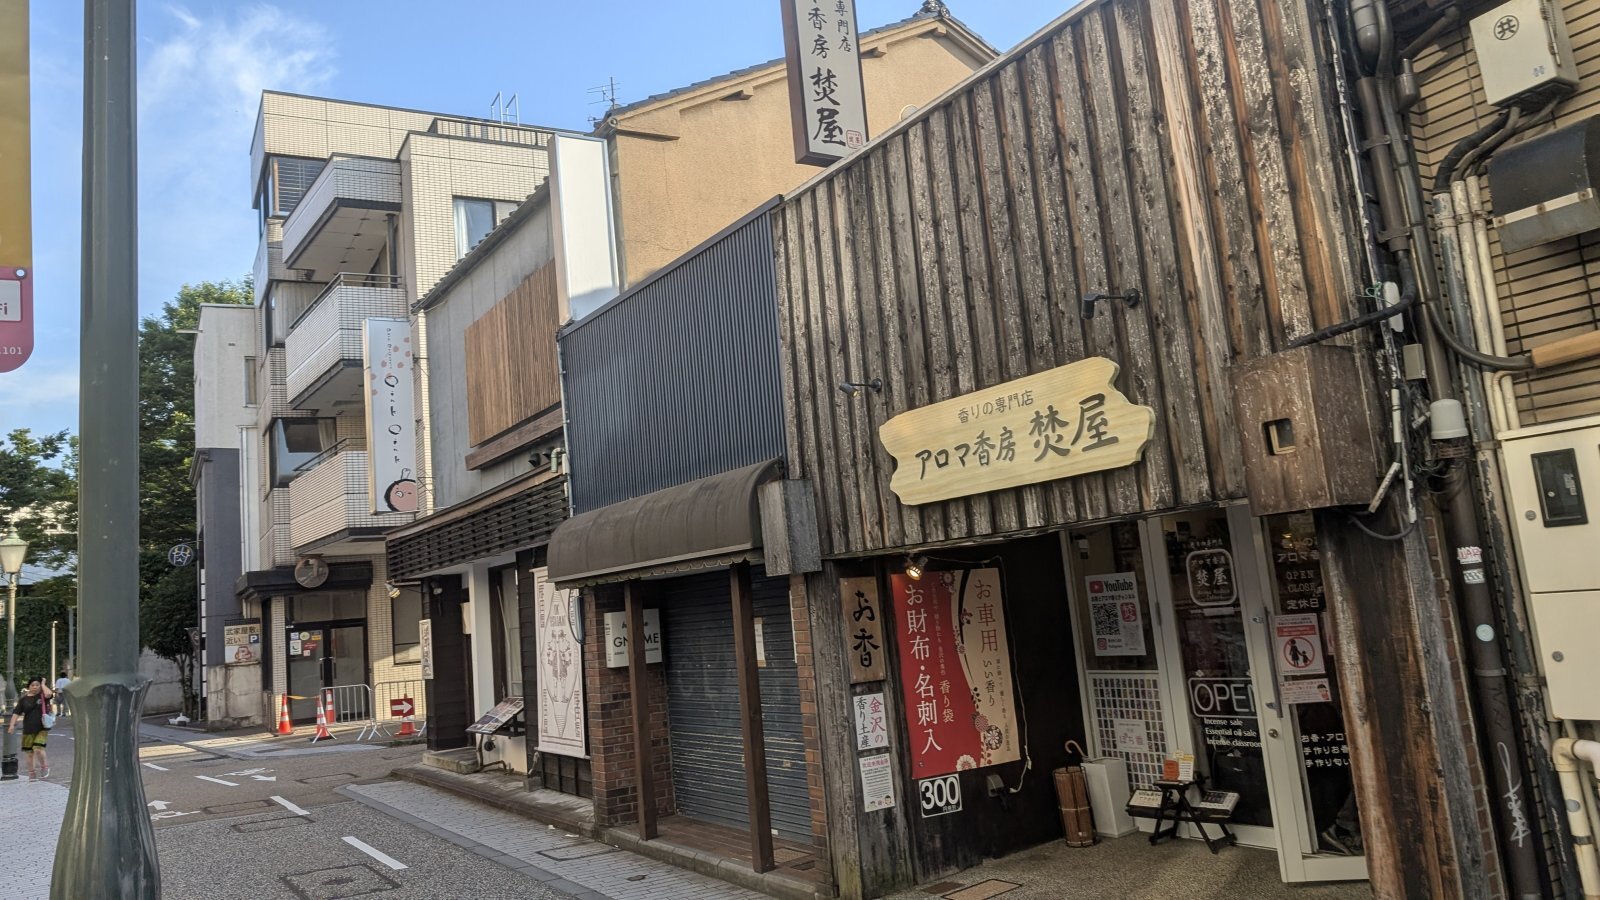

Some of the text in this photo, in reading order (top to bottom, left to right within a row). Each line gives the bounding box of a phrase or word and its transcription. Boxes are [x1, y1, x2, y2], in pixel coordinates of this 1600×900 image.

[1497, 18, 1516, 39] 共
[810, 67, 846, 146] 焚屋
[957, 389, 1034, 424] 香りの専門店
[915, 392, 1119, 480] アロマ香房 焚屋
[1104, 579, 1134, 592] YouTube
[1196, 567, 1228, 586] 焚屋
[1286, 570, 1315, 580] OPEN
[1288, 582, 1316, 593] CLOSE
[1286, 598, 1319, 610] 定休日
[250, 635, 258, 643] P
[853, 589, 880, 668] お香
[226, 637, 241, 645] 近い
[613, 632, 660, 648] GNME
[974, 579, 998, 708] お車用 いい香り
[904, 584, 943, 755] お財布・名刺入
[939, 680, 954, 723] 香り袋
[856, 696, 872, 748] 香り土産
[869, 696, 886, 744] 金沢の
[1204, 717, 1228, 726] Incense
[1205, 728, 1257, 737] Essential oil sale
[921, 776, 959, 810] 300
